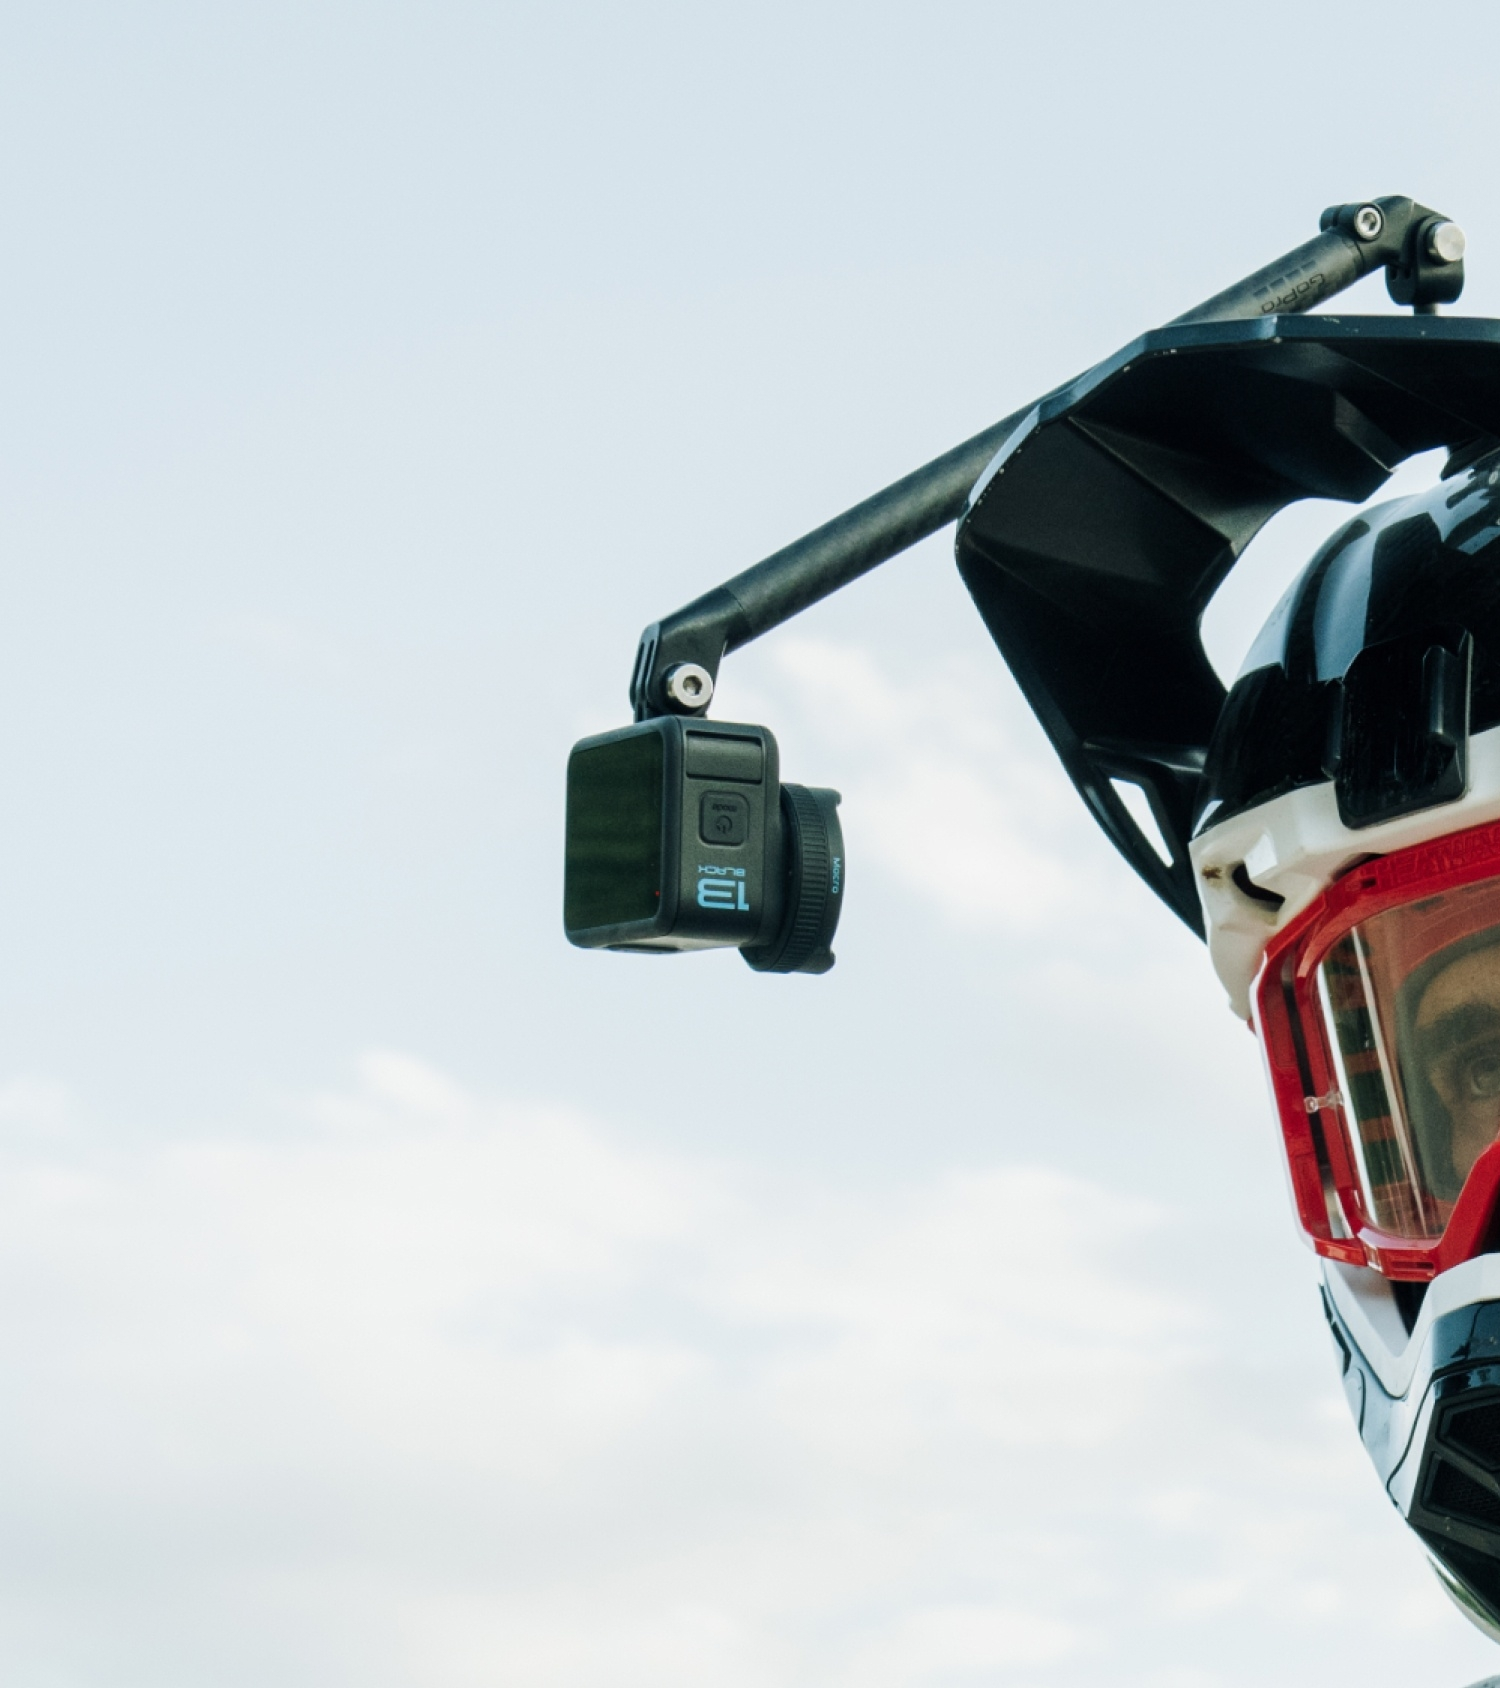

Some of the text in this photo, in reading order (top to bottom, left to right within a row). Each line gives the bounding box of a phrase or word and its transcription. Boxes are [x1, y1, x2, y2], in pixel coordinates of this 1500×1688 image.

[1260, 273, 1325, 314] GoPro
[698, 865, 746, 877] BLACK
[832, 857, 841, 893] Macro
[697, 878, 750, 911] 13
